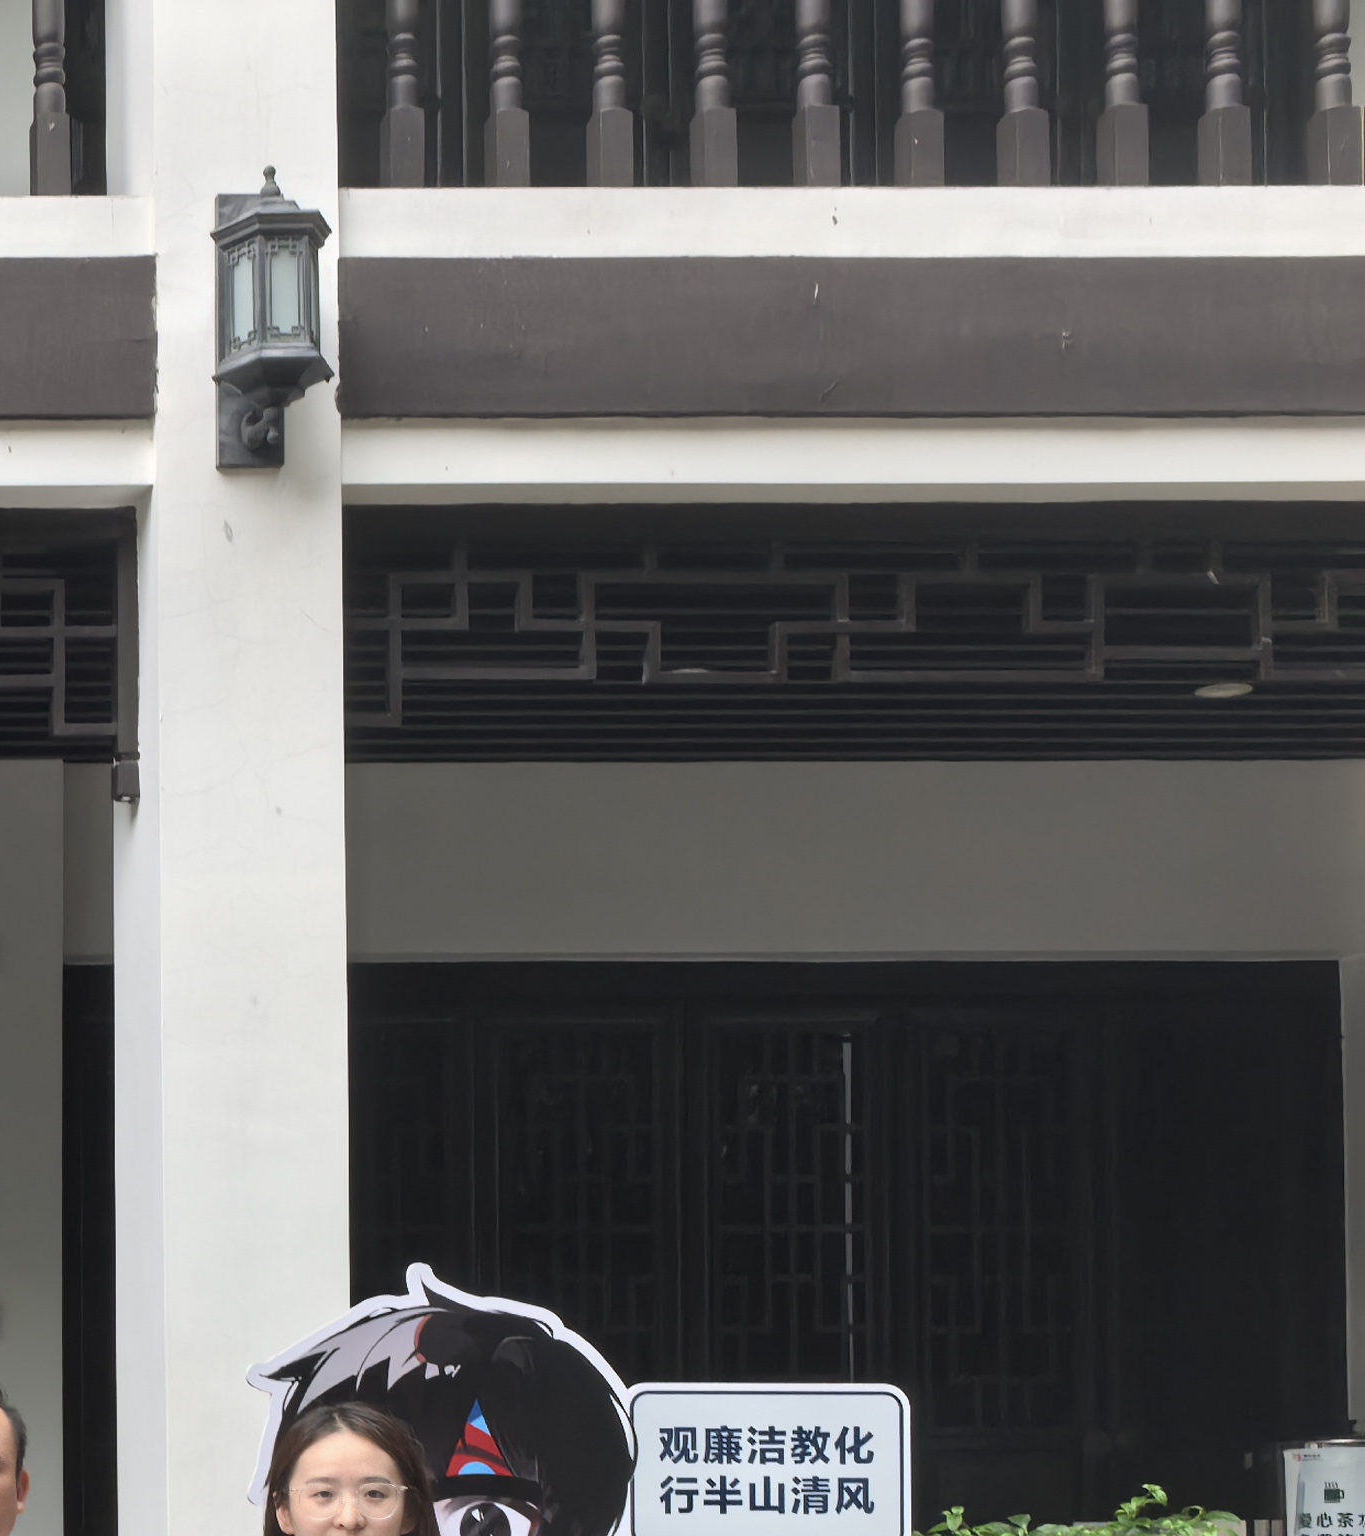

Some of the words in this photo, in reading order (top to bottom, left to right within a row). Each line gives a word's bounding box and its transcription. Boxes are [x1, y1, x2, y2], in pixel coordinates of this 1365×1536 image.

[659, 1425, 875, 1465] 观廉洁教化
[659, 1475, 875, 1515] 行半山清风
